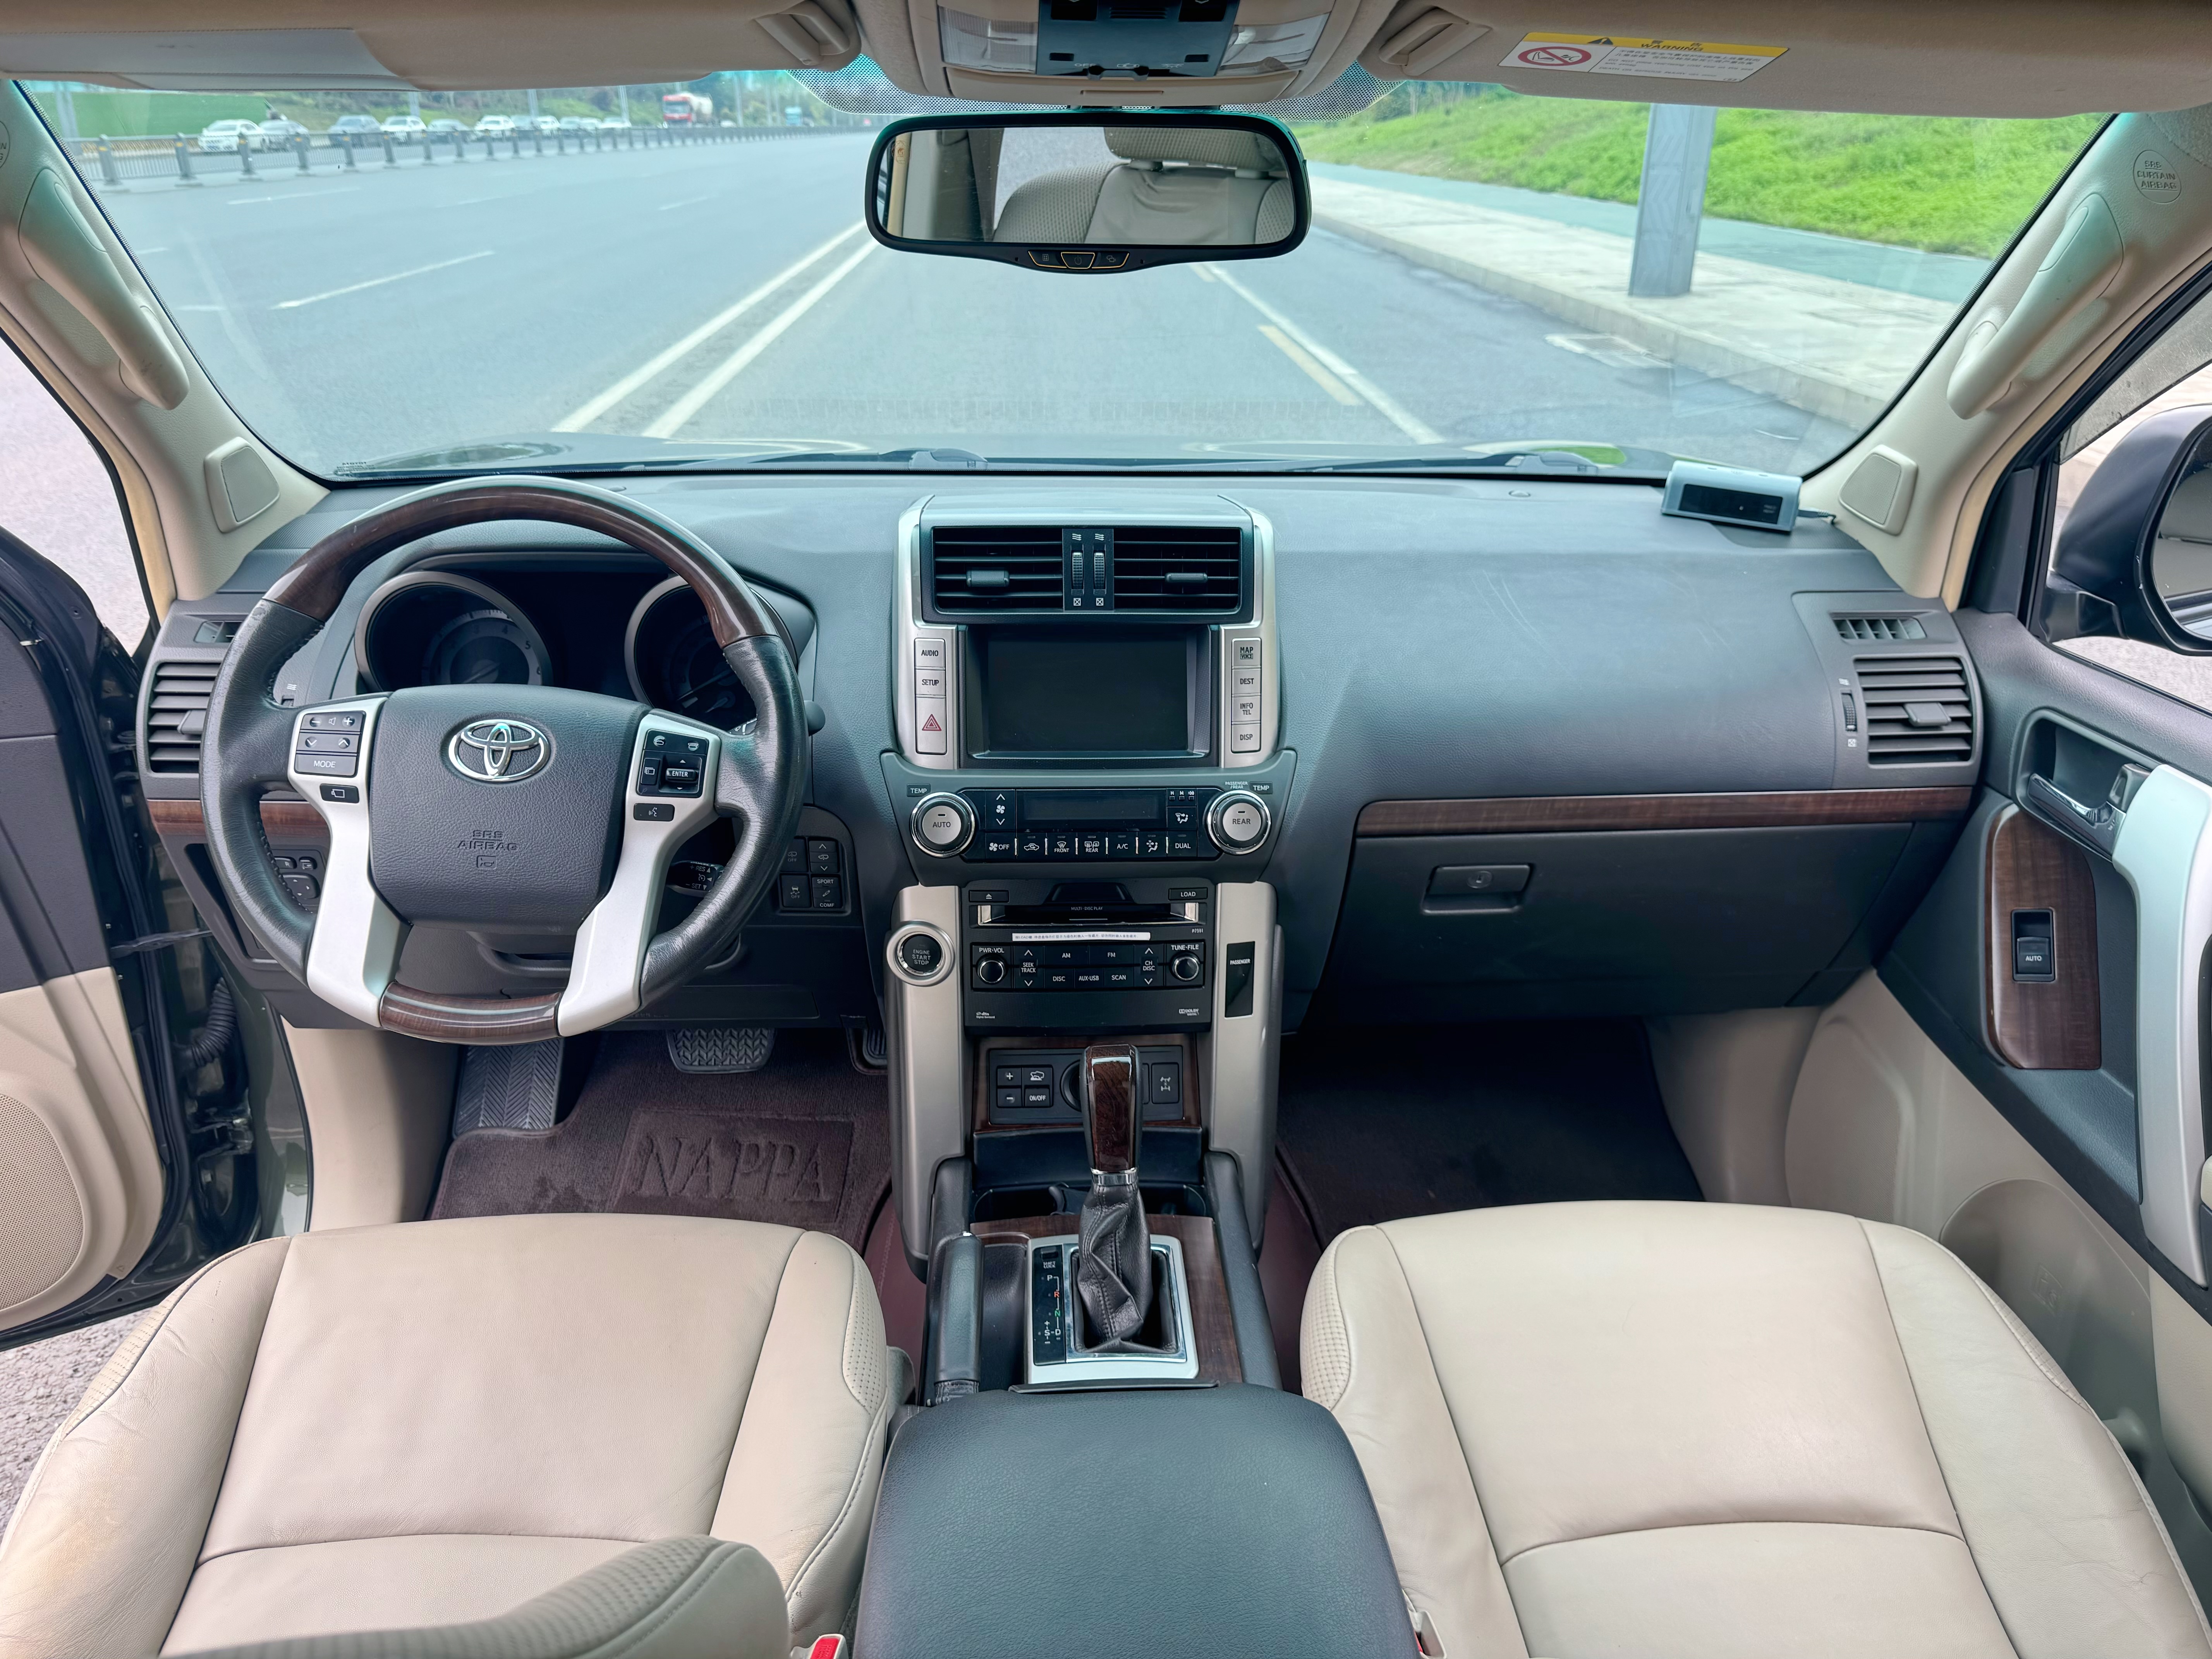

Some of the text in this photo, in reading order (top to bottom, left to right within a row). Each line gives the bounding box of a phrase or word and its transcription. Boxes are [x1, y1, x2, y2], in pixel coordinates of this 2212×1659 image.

[2137, 171, 2176, 180] CURTAIN
[2141, 180, 2176, 189] AIRBAG
[525, 641, 531, 650] 5
[473, 830, 503, 838] SRS
[457, 840, 518, 851] AIRBAG
[627, 1136, 831, 1202] NAPPA
